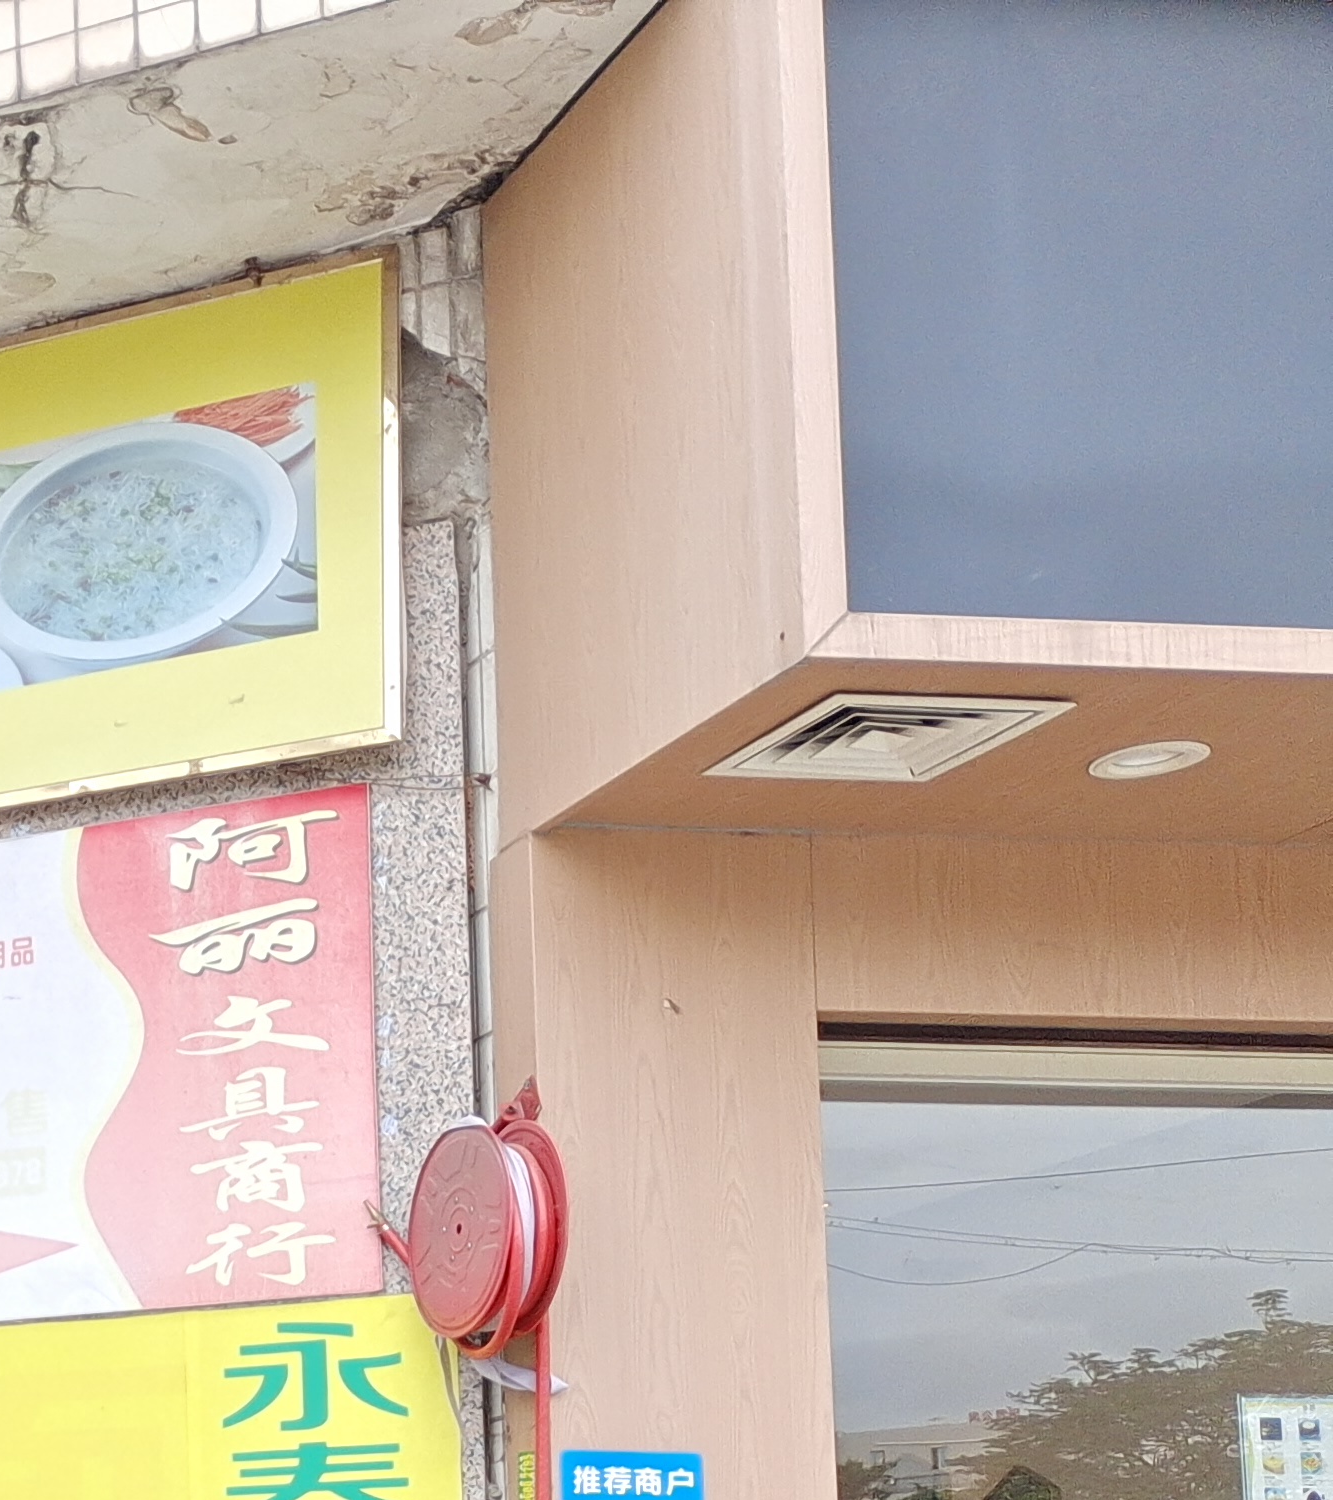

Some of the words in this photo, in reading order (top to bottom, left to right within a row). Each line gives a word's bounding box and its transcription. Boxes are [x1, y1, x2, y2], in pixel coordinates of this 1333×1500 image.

[147, 809, 338, 1287] 阿丽文具商行
[573, 1465, 695, 1496] 推荐商户
